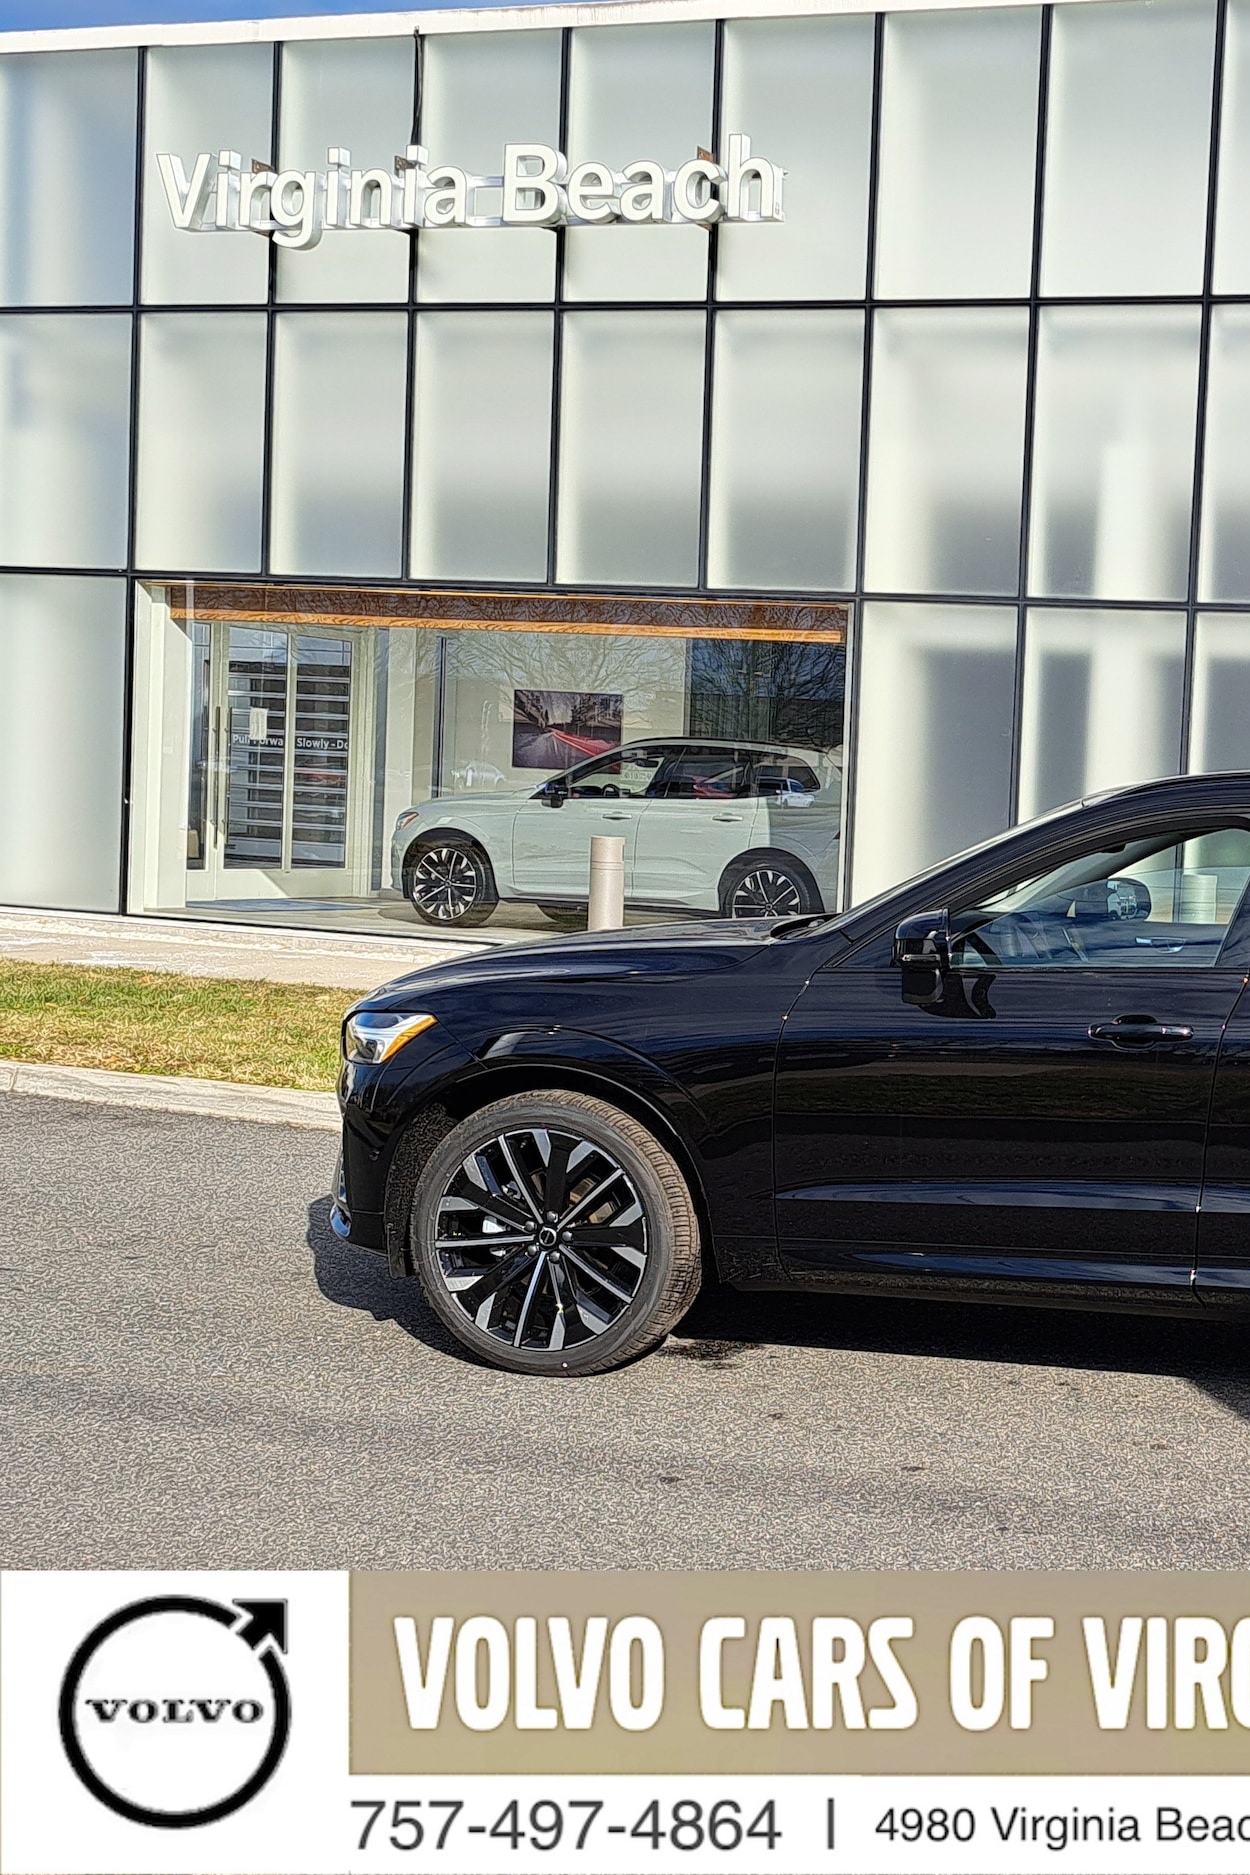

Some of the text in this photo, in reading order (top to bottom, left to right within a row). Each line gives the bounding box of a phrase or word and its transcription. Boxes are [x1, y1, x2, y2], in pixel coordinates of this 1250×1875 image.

[156, 133, 785, 250] Virginia Beach
[253, 736, 284, 746] orwa
[296, 737, 329, 750] Slowly
